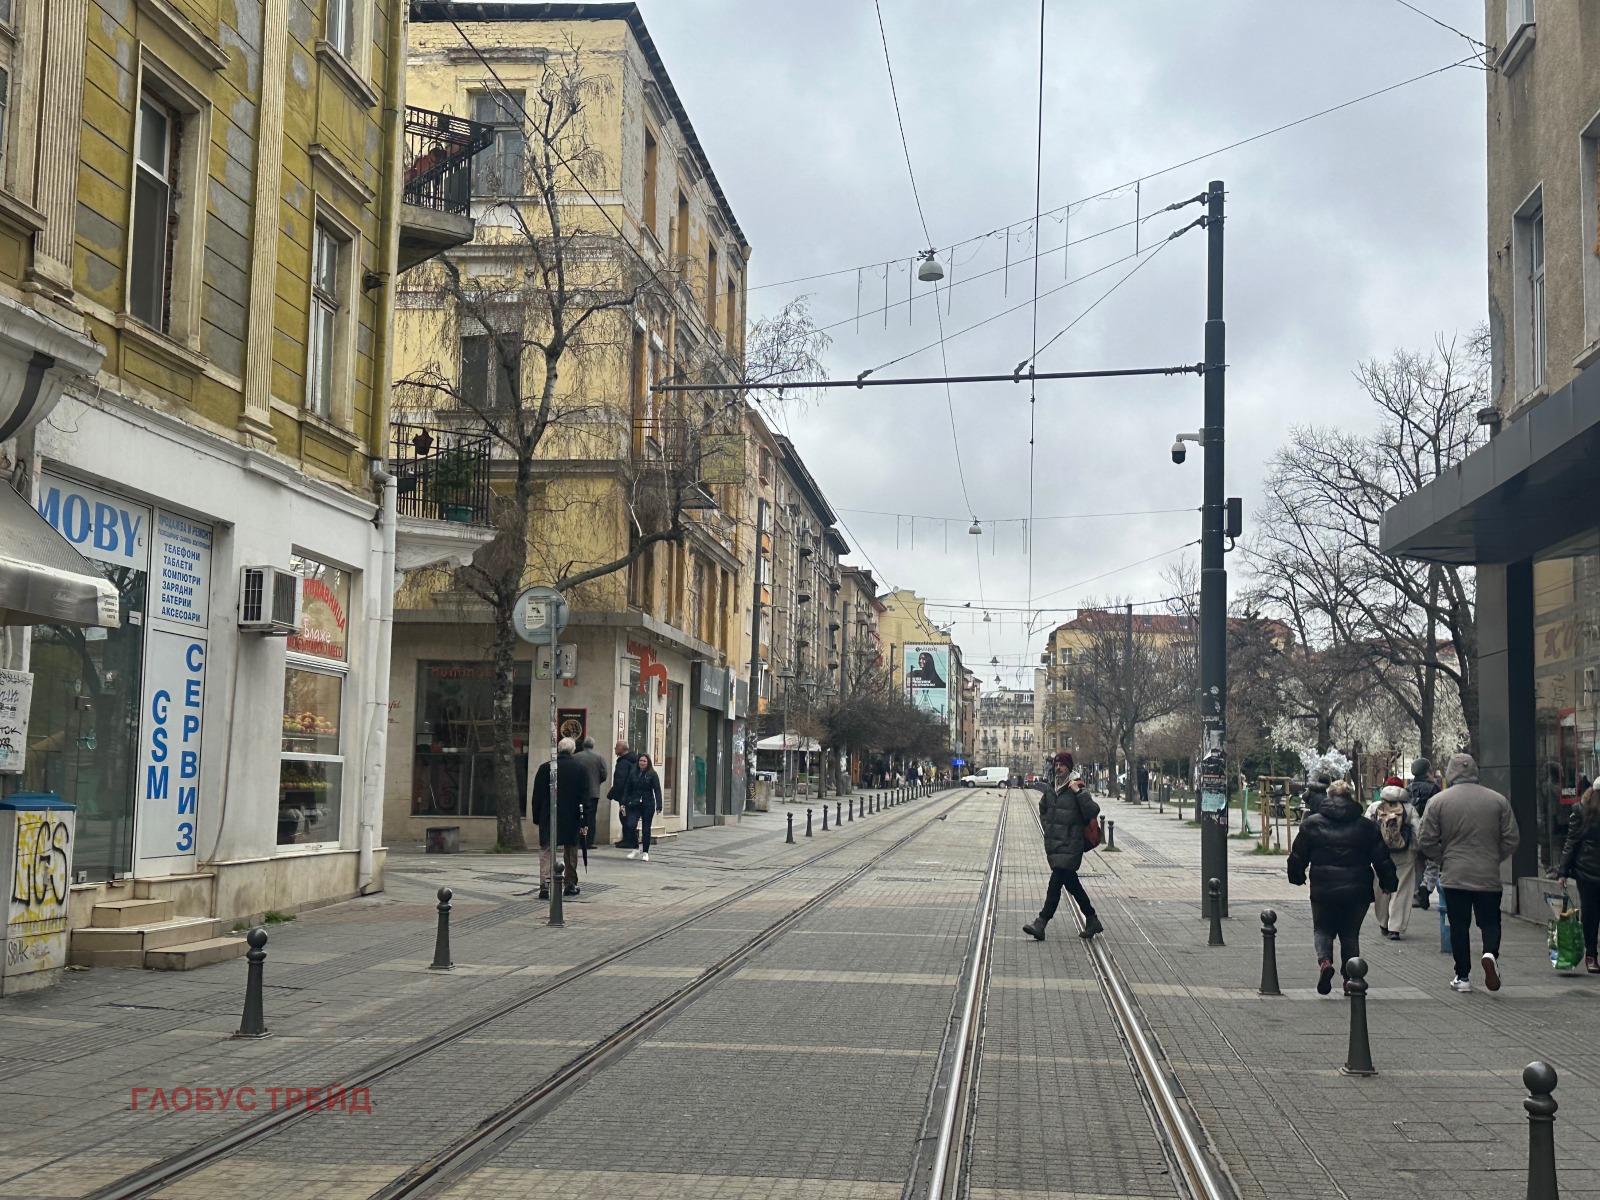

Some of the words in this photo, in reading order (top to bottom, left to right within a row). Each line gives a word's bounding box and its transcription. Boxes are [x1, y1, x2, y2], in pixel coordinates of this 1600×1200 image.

[164, 543, 201, 561] ТЕЛЕФОНИ
[163, 556, 193, 571] ТАБЛЕТИ
[162, 568, 201, 586] КОМПЮТРИ
[162, 581, 193, 596] ЗАРЯДНИ
[161, 593, 192, 608] БАТЕРИИ
[161, 607, 201, 622] АКСЕСОАРИ
[146, 689, 171, 800] GSM
[176, 643, 204, 851] СЕРВИЗ
